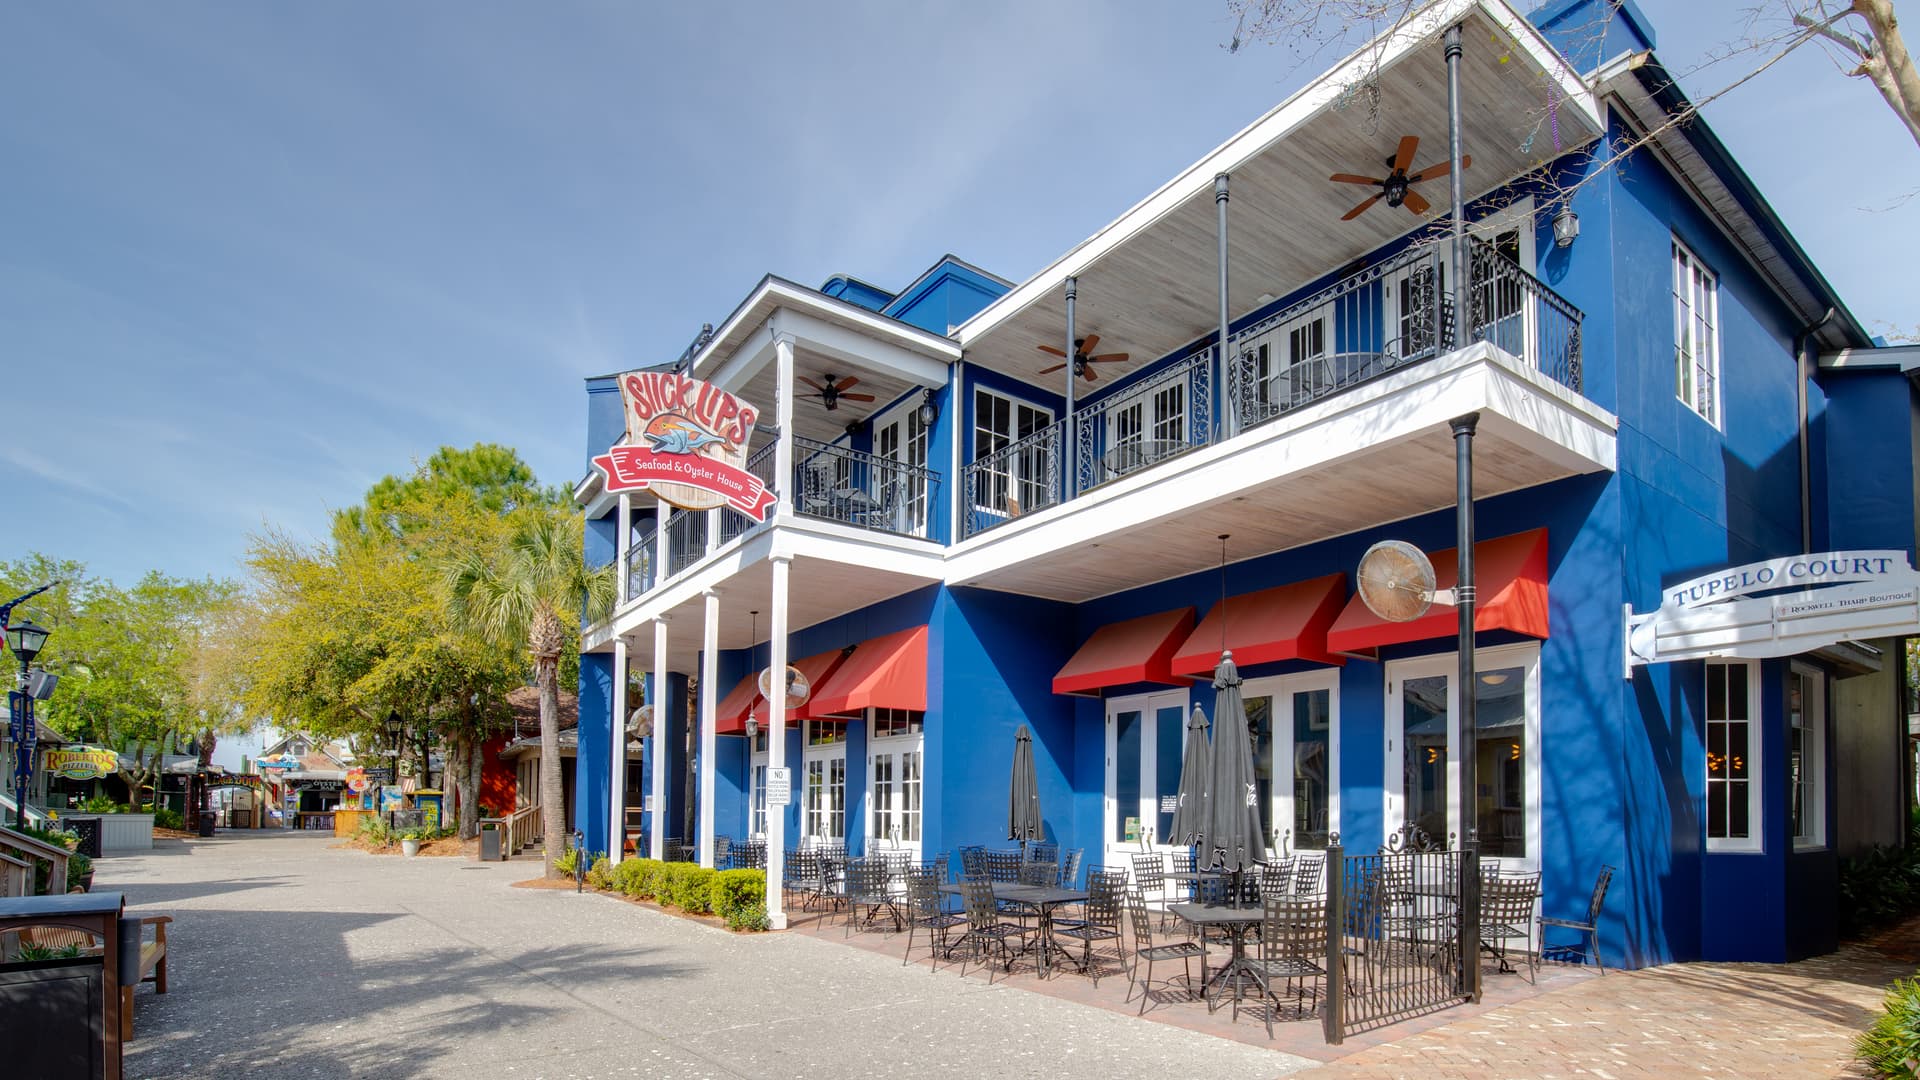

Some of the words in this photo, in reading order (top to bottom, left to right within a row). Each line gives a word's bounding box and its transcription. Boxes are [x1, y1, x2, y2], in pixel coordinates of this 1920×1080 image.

[626, 373, 694, 420] SLICK
[695, 379, 755, 444] LIPS
[635, 458, 673, 471] Seafood
[674, 460, 683, 472] &
[684, 463, 714, 480] Oyster
[717, 469, 744, 491] House
[1672, 567, 1774, 608] TUPELO
[1789, 558, 1893, 578] COURT
[1869, 591, 1913, 603] BOUTIQUE
[775, 771, 783, 779] NO
